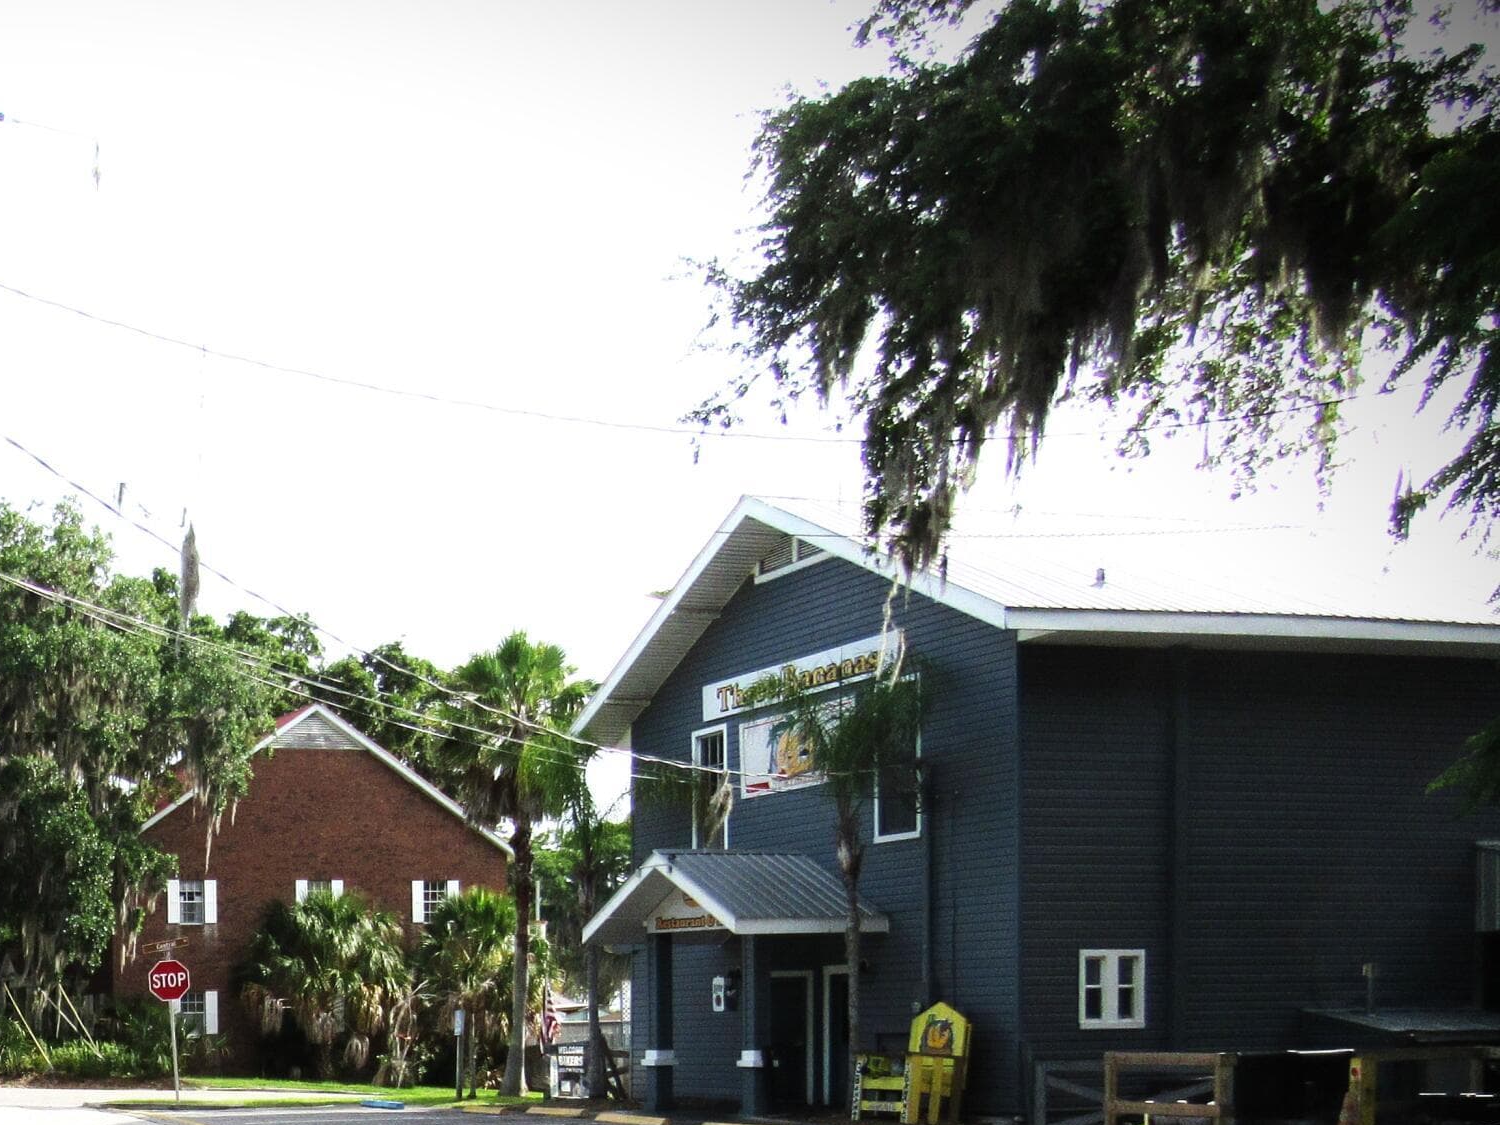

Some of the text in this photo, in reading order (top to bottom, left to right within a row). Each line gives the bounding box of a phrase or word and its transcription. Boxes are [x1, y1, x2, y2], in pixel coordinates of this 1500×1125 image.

[781, 650, 882, 695] Bananas
[656, 916, 705, 930] Restaurant
[152, 972, 186, 989] STOP
